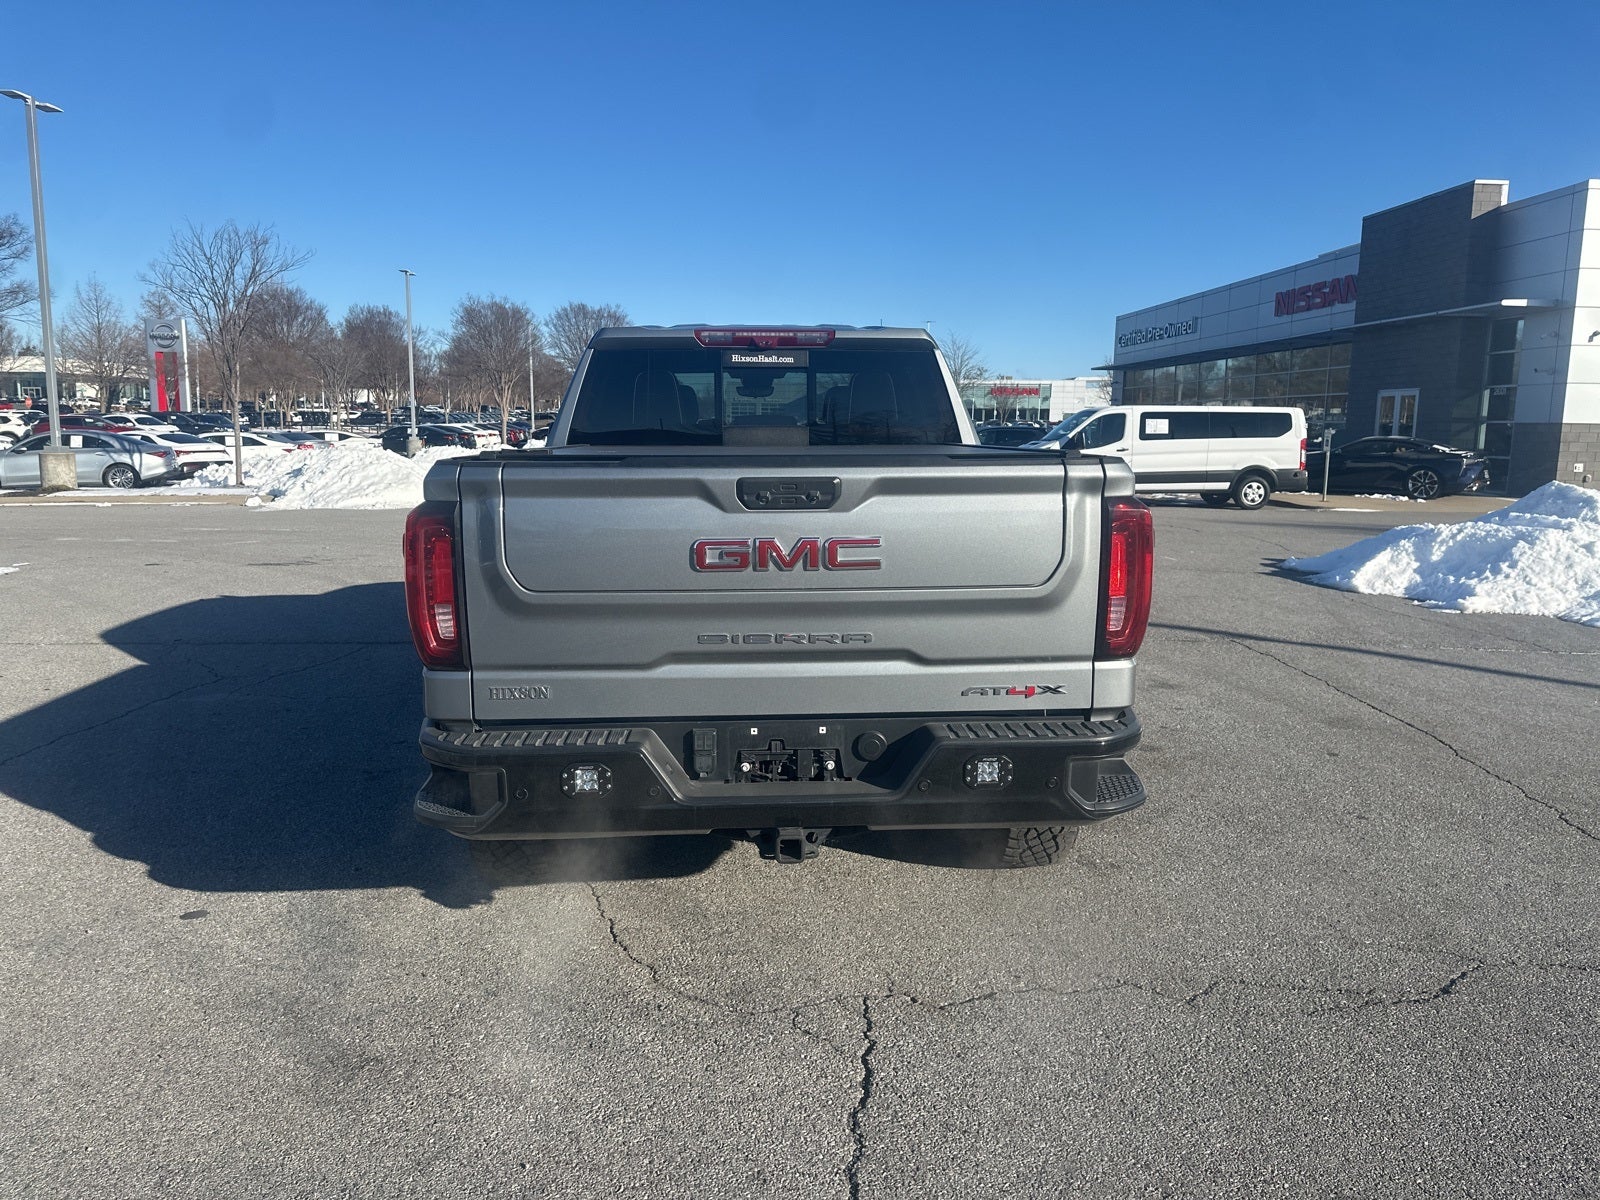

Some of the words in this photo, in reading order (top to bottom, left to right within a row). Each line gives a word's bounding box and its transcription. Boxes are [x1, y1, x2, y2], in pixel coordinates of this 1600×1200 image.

[1274, 274, 1357, 317] NISSAN
[1117, 328, 1146, 347] Certified
[1147, 316, 1197, 342] Pre-Owned
[731, 354, 794, 363] HixsonHasIt.com
[689, 536, 882, 572] GMC
[697, 633, 873, 645] SIERRA
[488, 686, 551, 700] HIXSON
[960, 683, 1068, 699] AT4X
